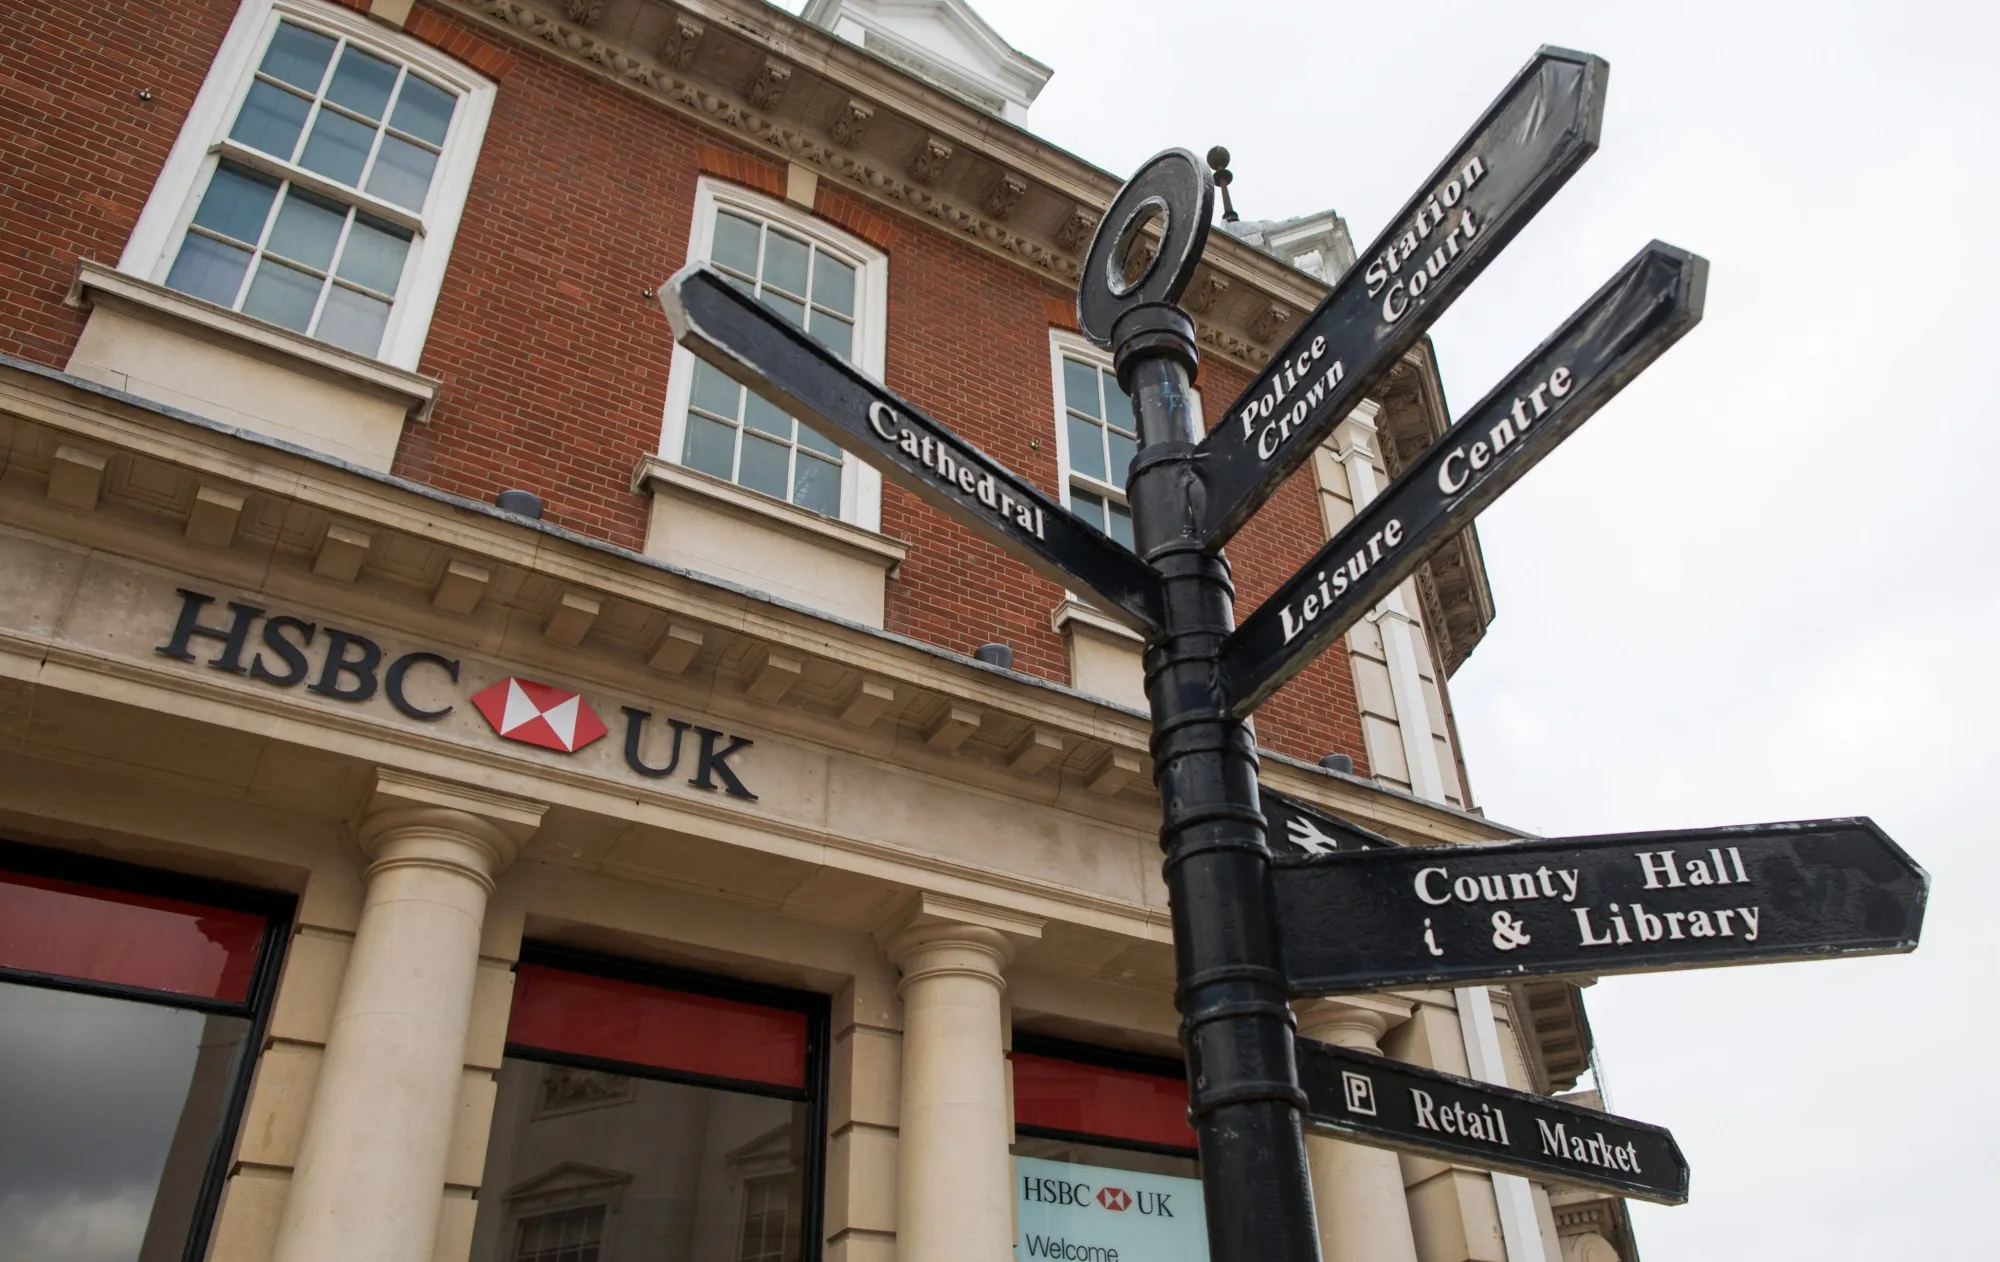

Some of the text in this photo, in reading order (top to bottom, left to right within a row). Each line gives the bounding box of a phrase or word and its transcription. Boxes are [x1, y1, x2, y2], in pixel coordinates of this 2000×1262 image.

[1239, 155, 1487, 441] Police Station
[1257, 208, 1479, 461] Crown Court
[868, 400, 1046, 541] Cathedral
[1278, 366, 1573, 645] Leisure Centre
[156, 588, 759, 801] HSBC UK
[1414, 847, 1750, 906] County Hall
[1491, 910, 1531, 951] &
[1571, 902, 1761, 947] Library
[1350, 1079, 1642, 1175] P Retail Market
[1023, 1176, 1175, 1218] HSBC UK
[1026, 1233, 1119, 1262] Welcome
